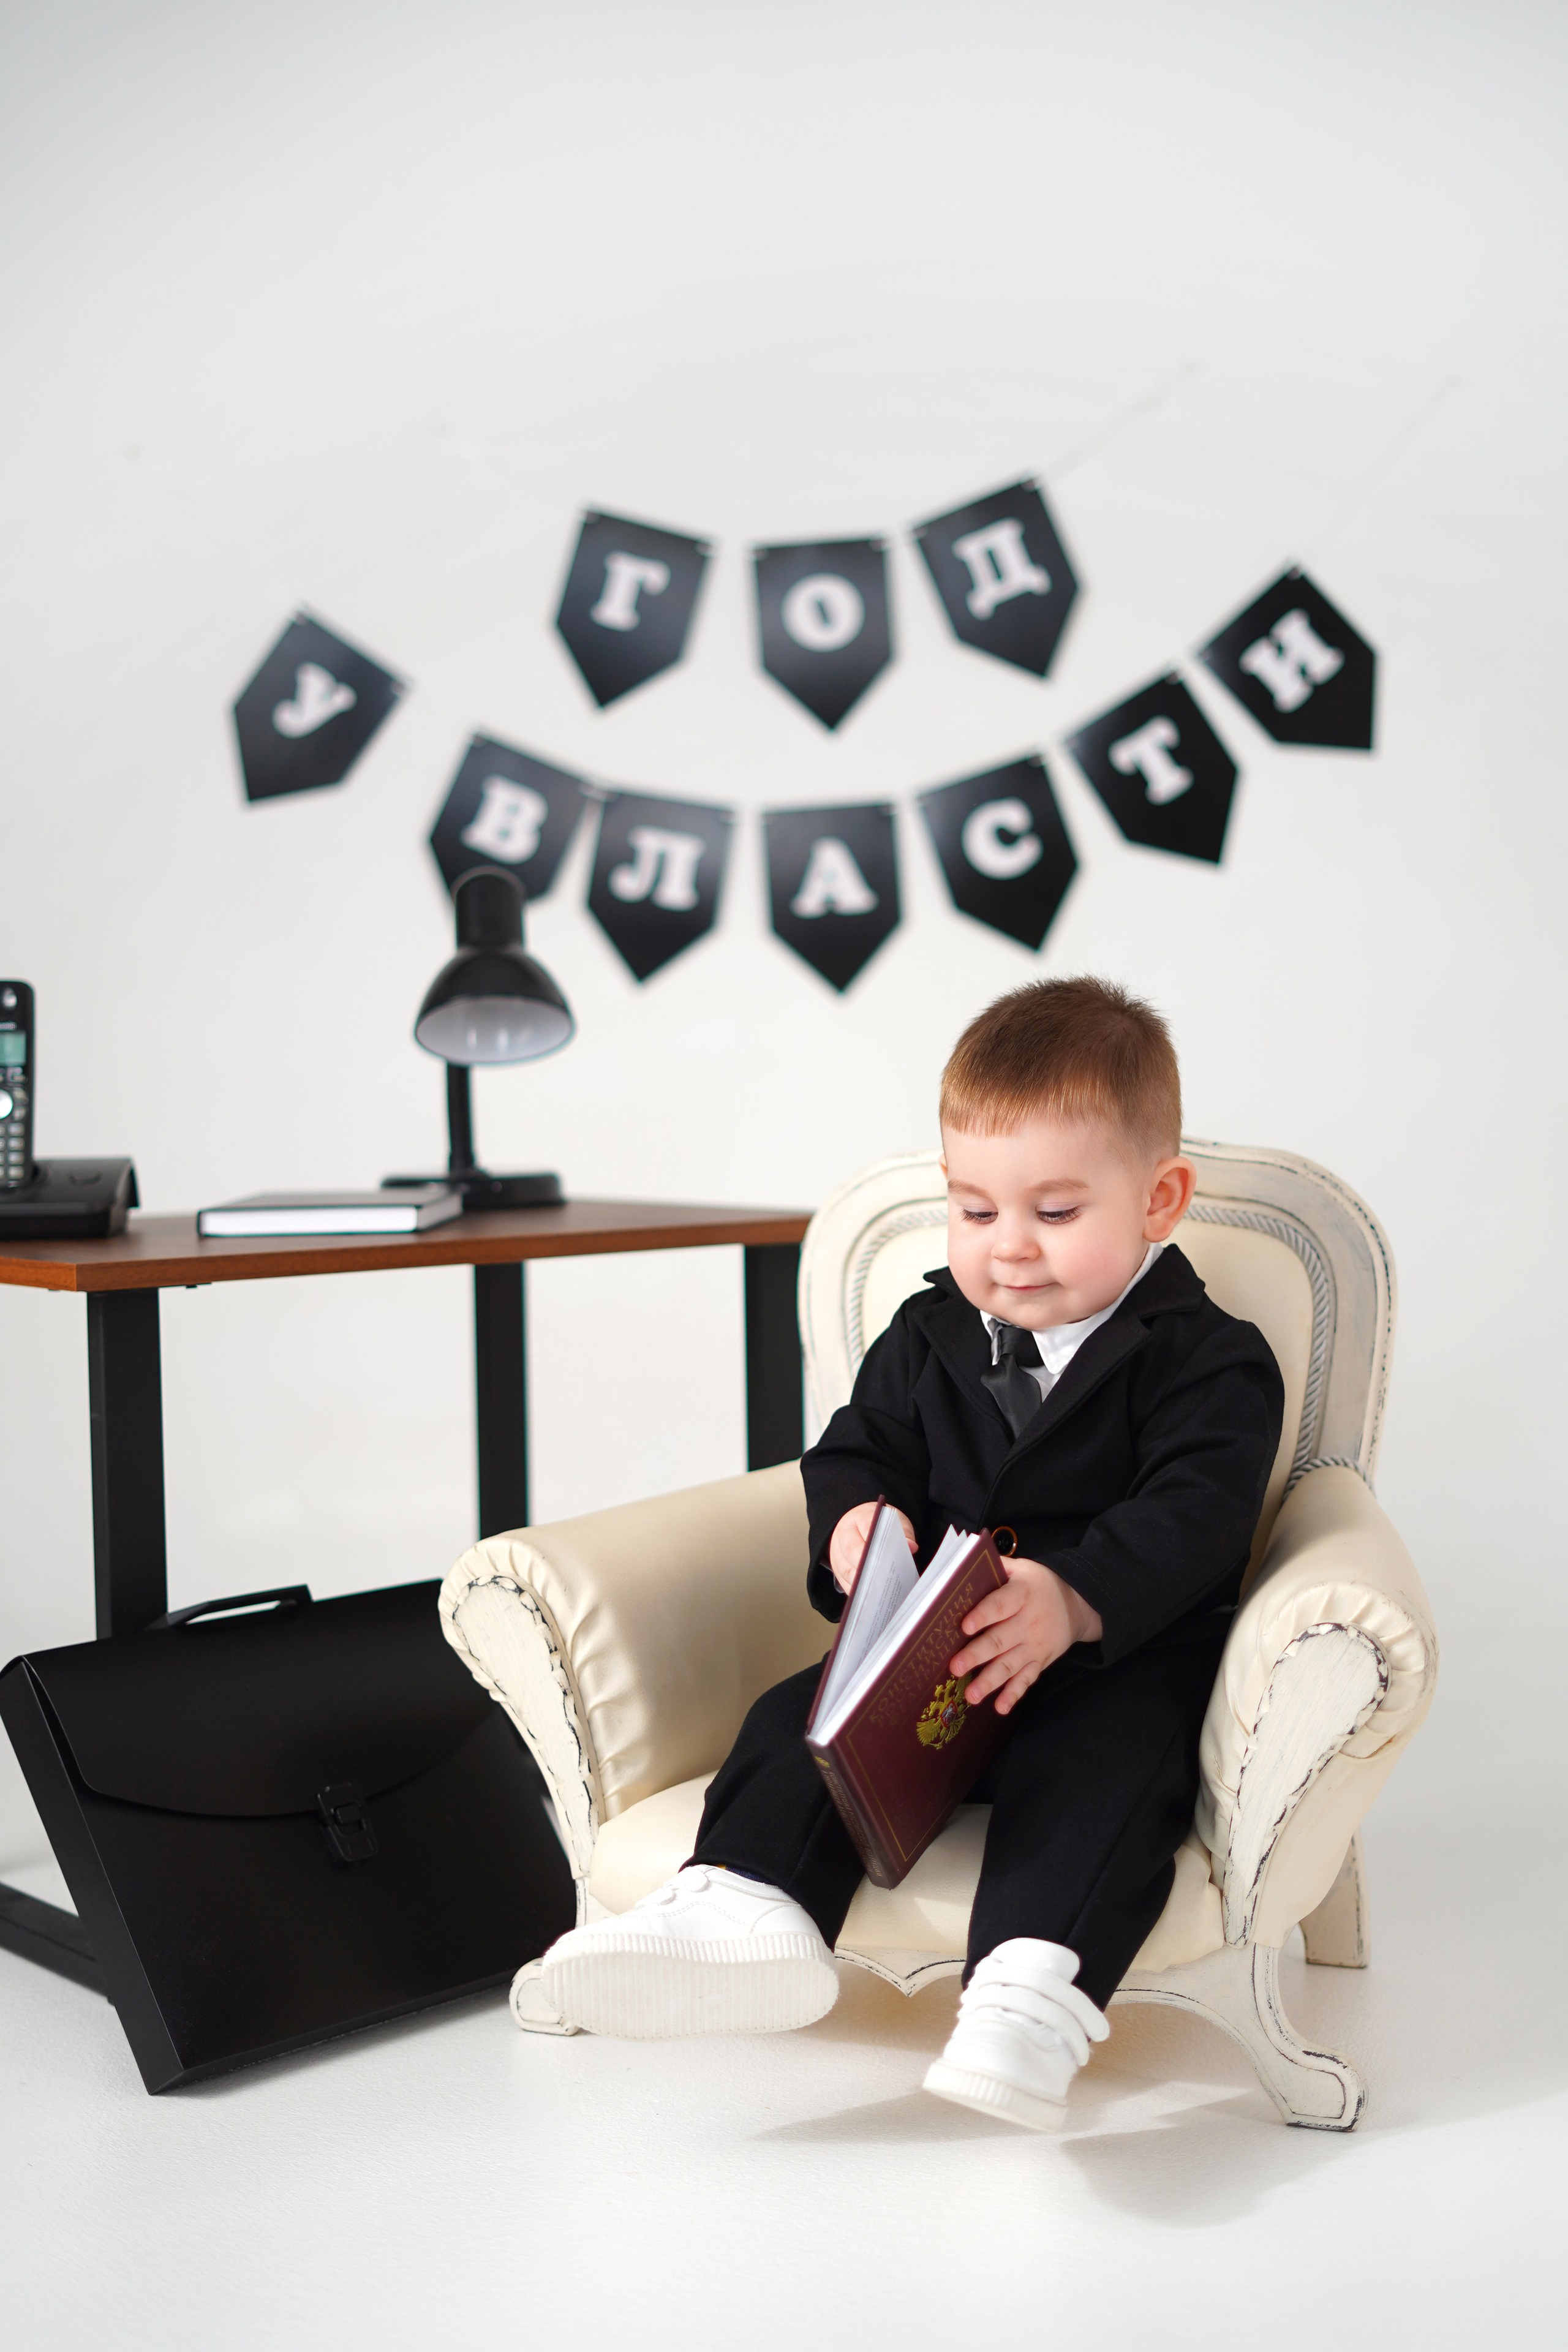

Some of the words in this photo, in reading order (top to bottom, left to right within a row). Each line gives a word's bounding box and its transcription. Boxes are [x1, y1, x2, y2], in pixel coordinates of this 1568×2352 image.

[591, 519, 1050, 652] ГОД
[273, 662, 355, 737] У
[464, 611, 1341, 918] ВЛАСТИ
[870, 1581, 973, 1724] КОНСТИТУЦИЯ
[888, 1629, 960, 1726] ФЕДЕРАЦИ
